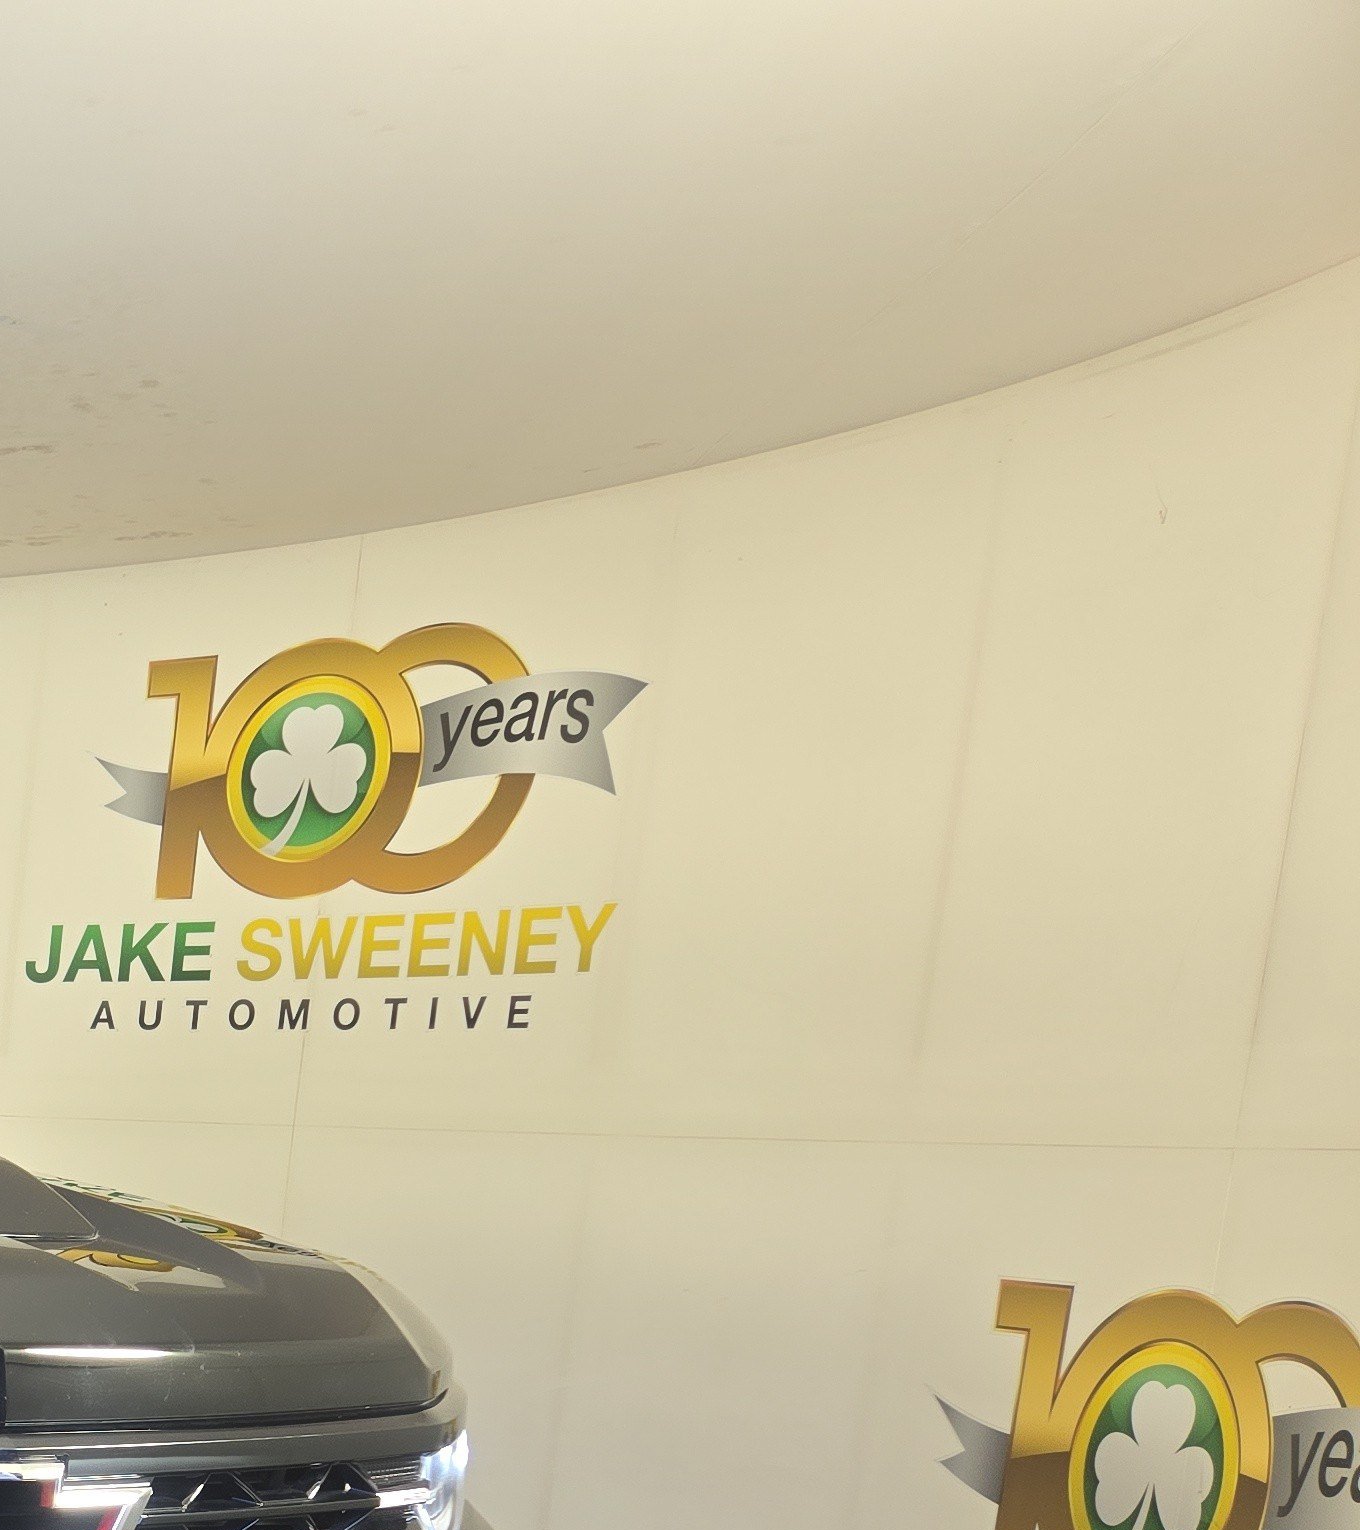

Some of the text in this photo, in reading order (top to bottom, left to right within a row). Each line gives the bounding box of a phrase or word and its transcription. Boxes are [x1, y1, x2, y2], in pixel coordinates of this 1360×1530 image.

[432, 686, 595, 773] years
[25, 902, 618, 984] JAKE SWEENEY
[90, 994, 533, 1031] AUTOMOTIVE
